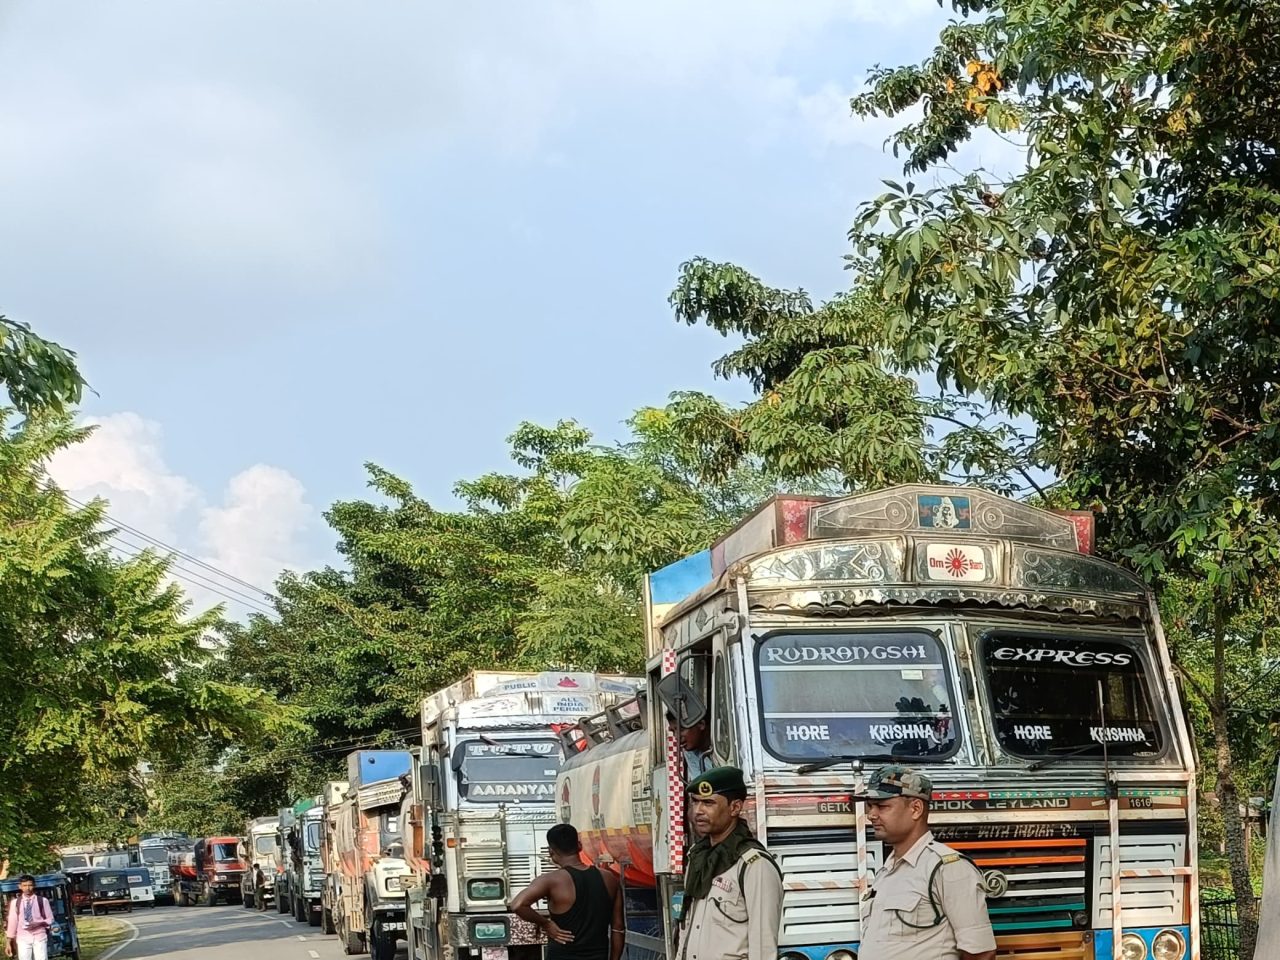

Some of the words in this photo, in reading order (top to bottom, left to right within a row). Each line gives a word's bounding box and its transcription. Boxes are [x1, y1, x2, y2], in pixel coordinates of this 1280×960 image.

[993, 647, 1132, 667] EXPRESS
[504, 682, 537, 690] PUBLIC
[786, 725, 830, 741] HORE
[869, 725, 940, 744] KRISHNA
[1014, 725, 1053, 740] HORE
[1089, 727, 1152, 747] KRISHNA
[928, 801, 974, 810] SHOK
[986, 799, 1069, 809] LEYLAND
